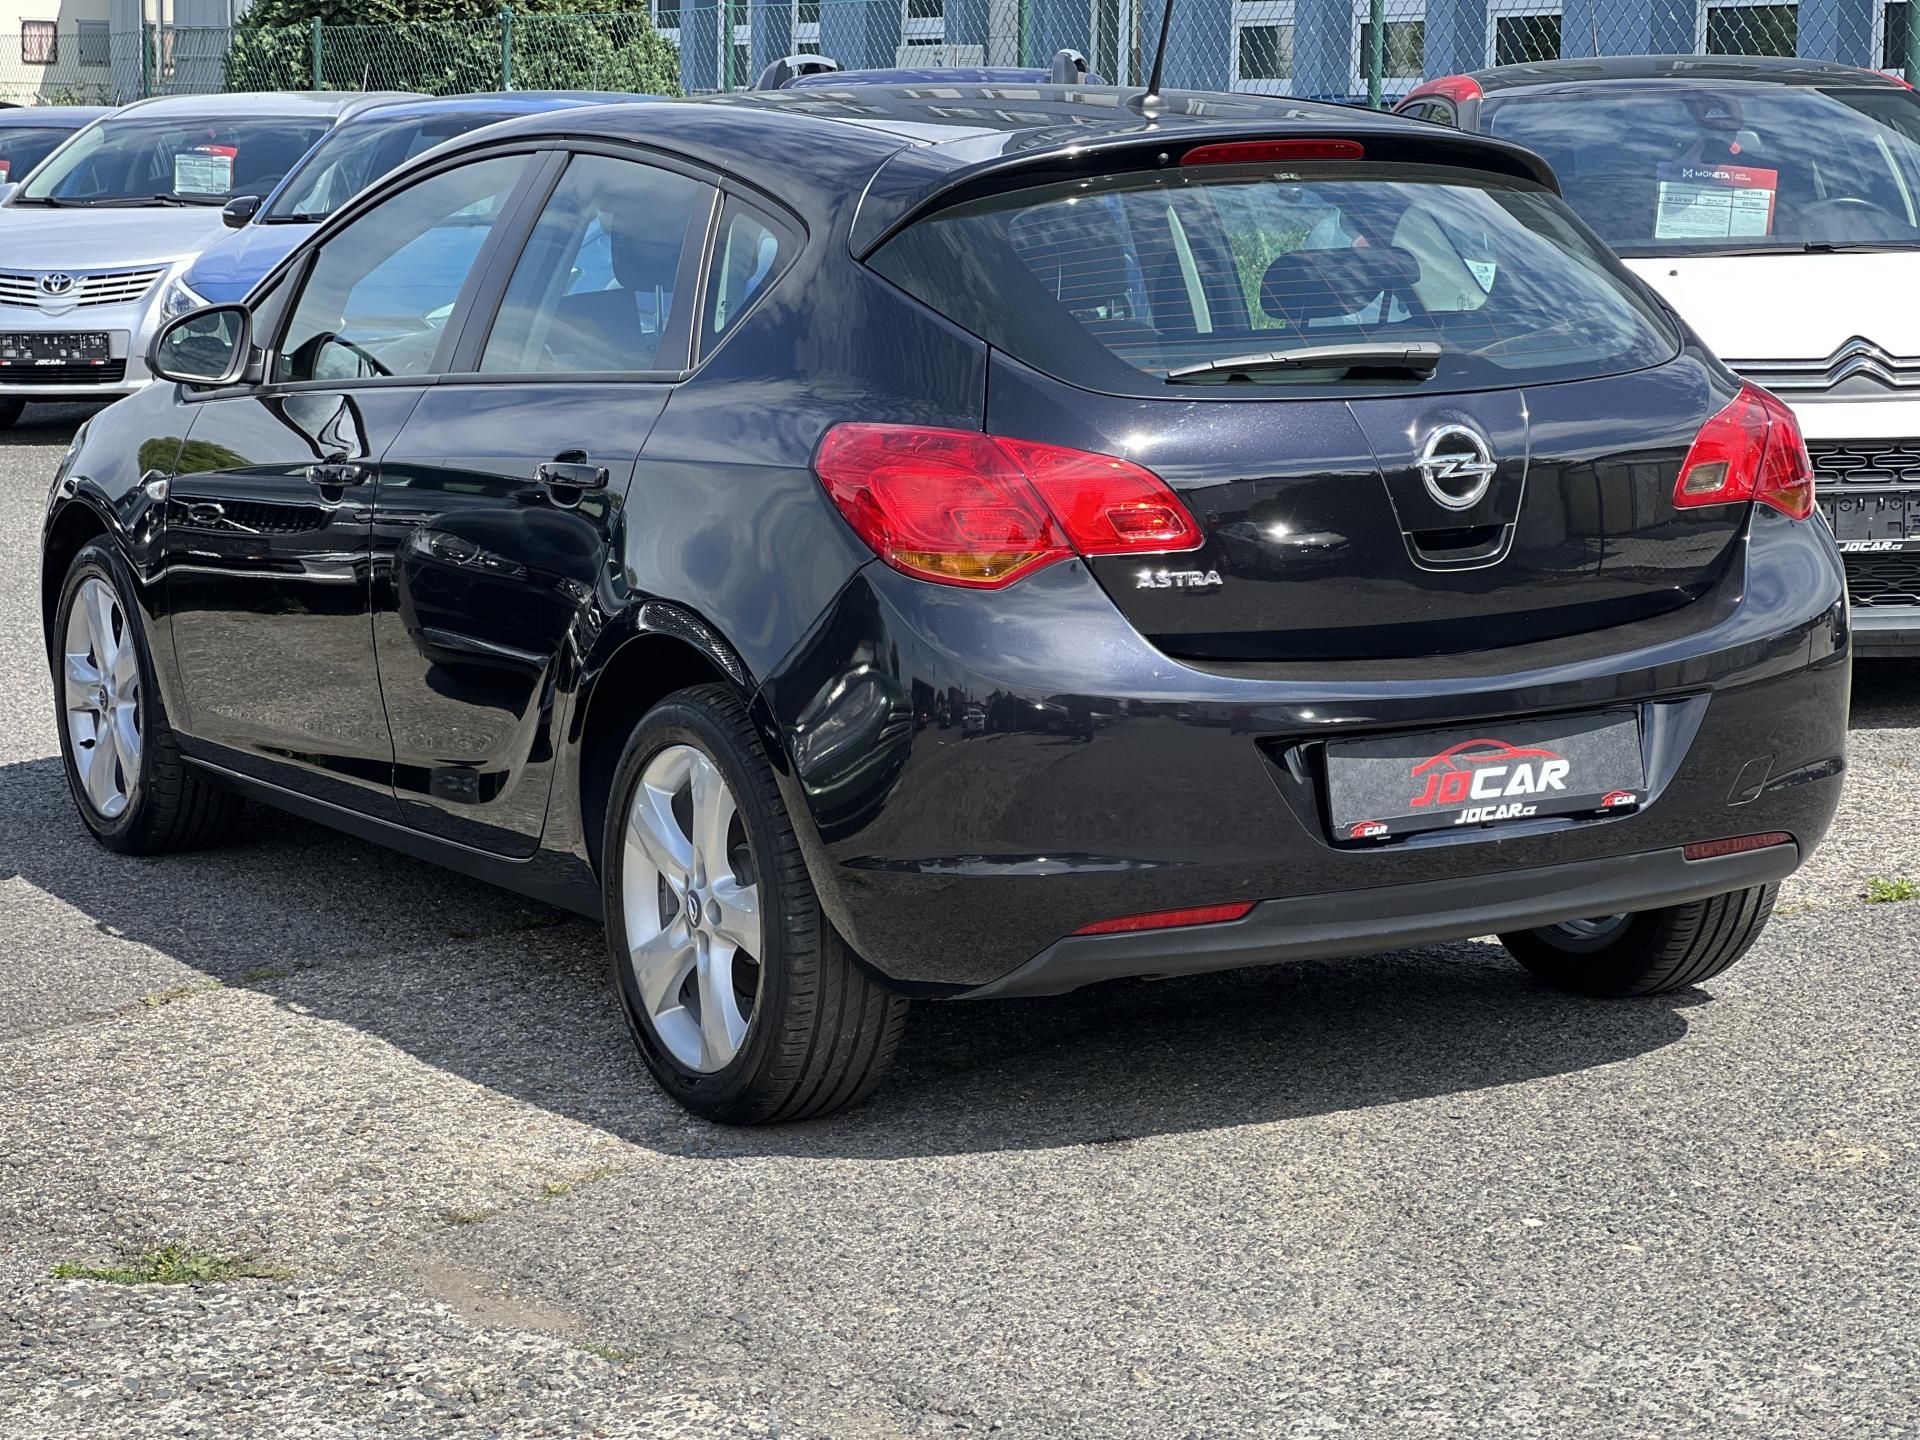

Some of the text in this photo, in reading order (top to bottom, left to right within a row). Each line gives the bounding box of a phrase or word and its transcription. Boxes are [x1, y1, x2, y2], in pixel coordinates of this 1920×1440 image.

[1695, 169, 1730, 180] MONETA
[1135, 568, 1224, 589] ASTRA
[1409, 759, 1570, 808] JOCAR
[1601, 793, 1637, 807] JOCAR
[1454, 802, 1537, 825] JOCAR.cz
[1350, 824, 1388, 839] JOCAR
